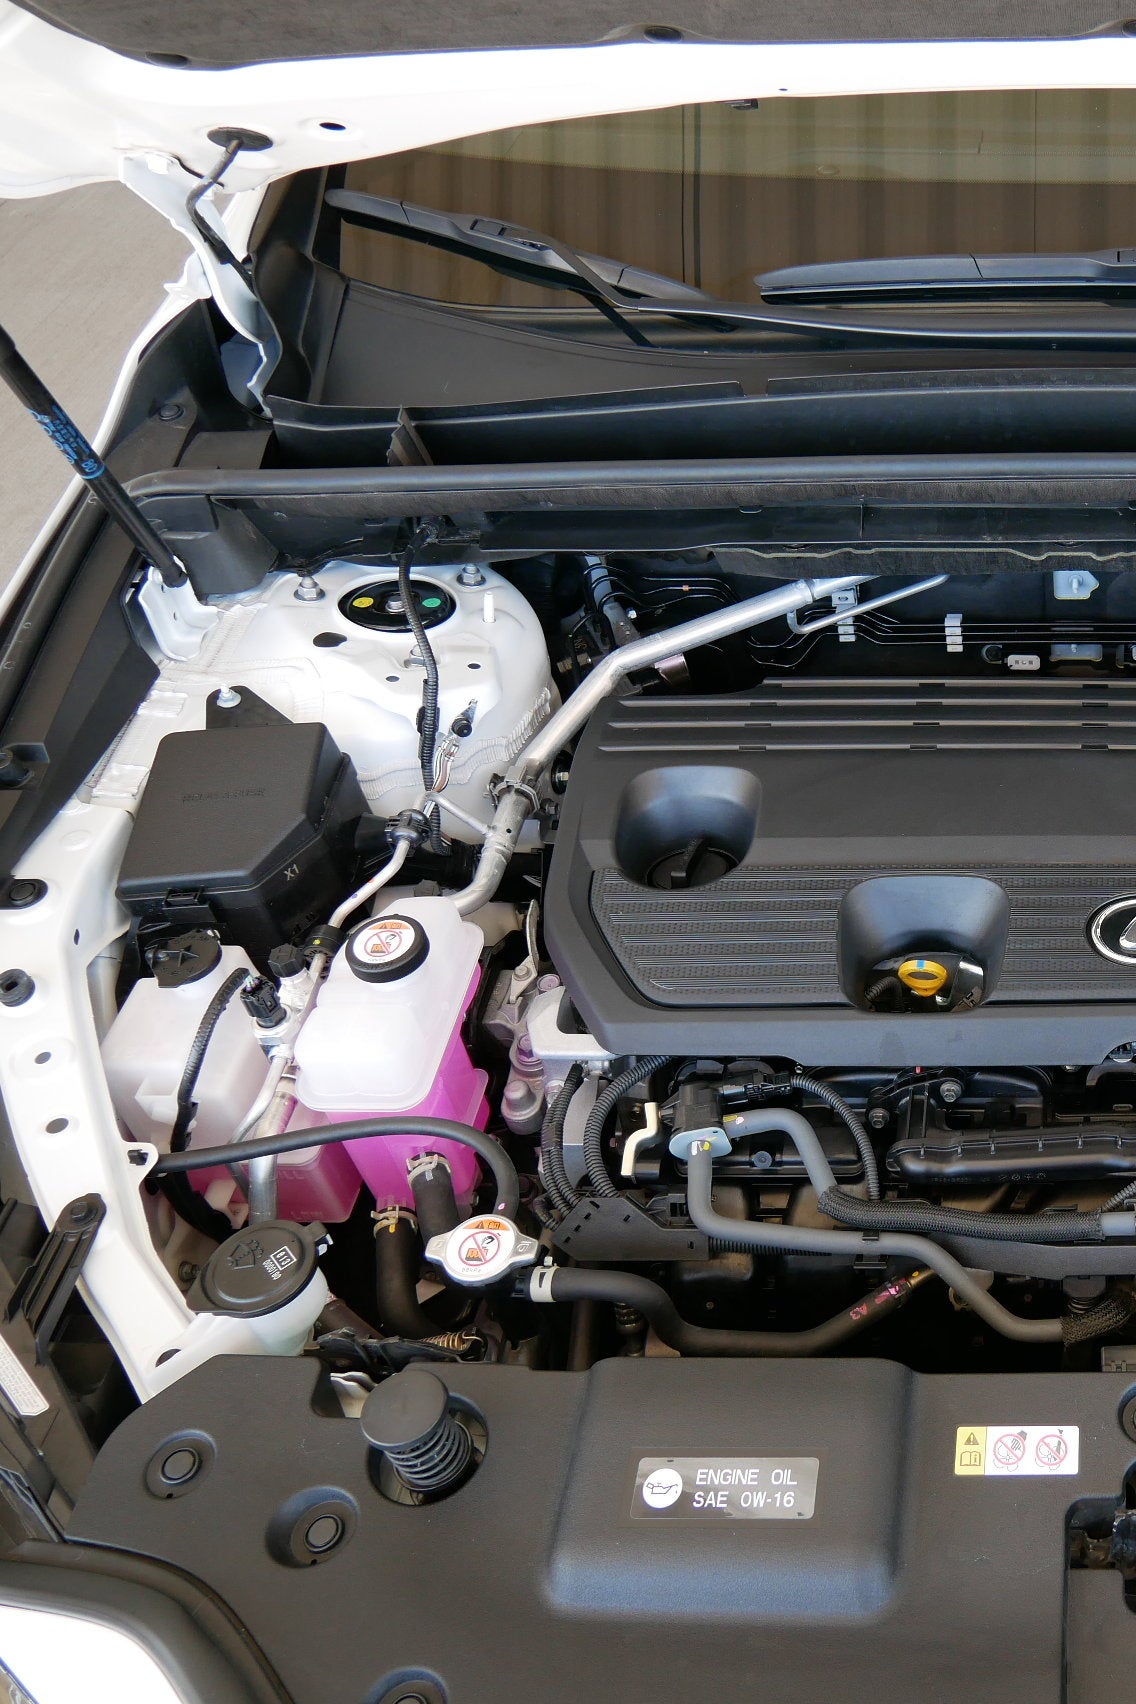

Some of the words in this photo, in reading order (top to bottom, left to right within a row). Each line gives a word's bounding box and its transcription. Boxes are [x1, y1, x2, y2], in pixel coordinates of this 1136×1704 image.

[695, 1468, 760, 1485] ENGINE
[770, 1468, 798, 1485] OIL
[692, 1491, 730, 1508] SAE
[740, 1491, 795, 1508] 0W-16
